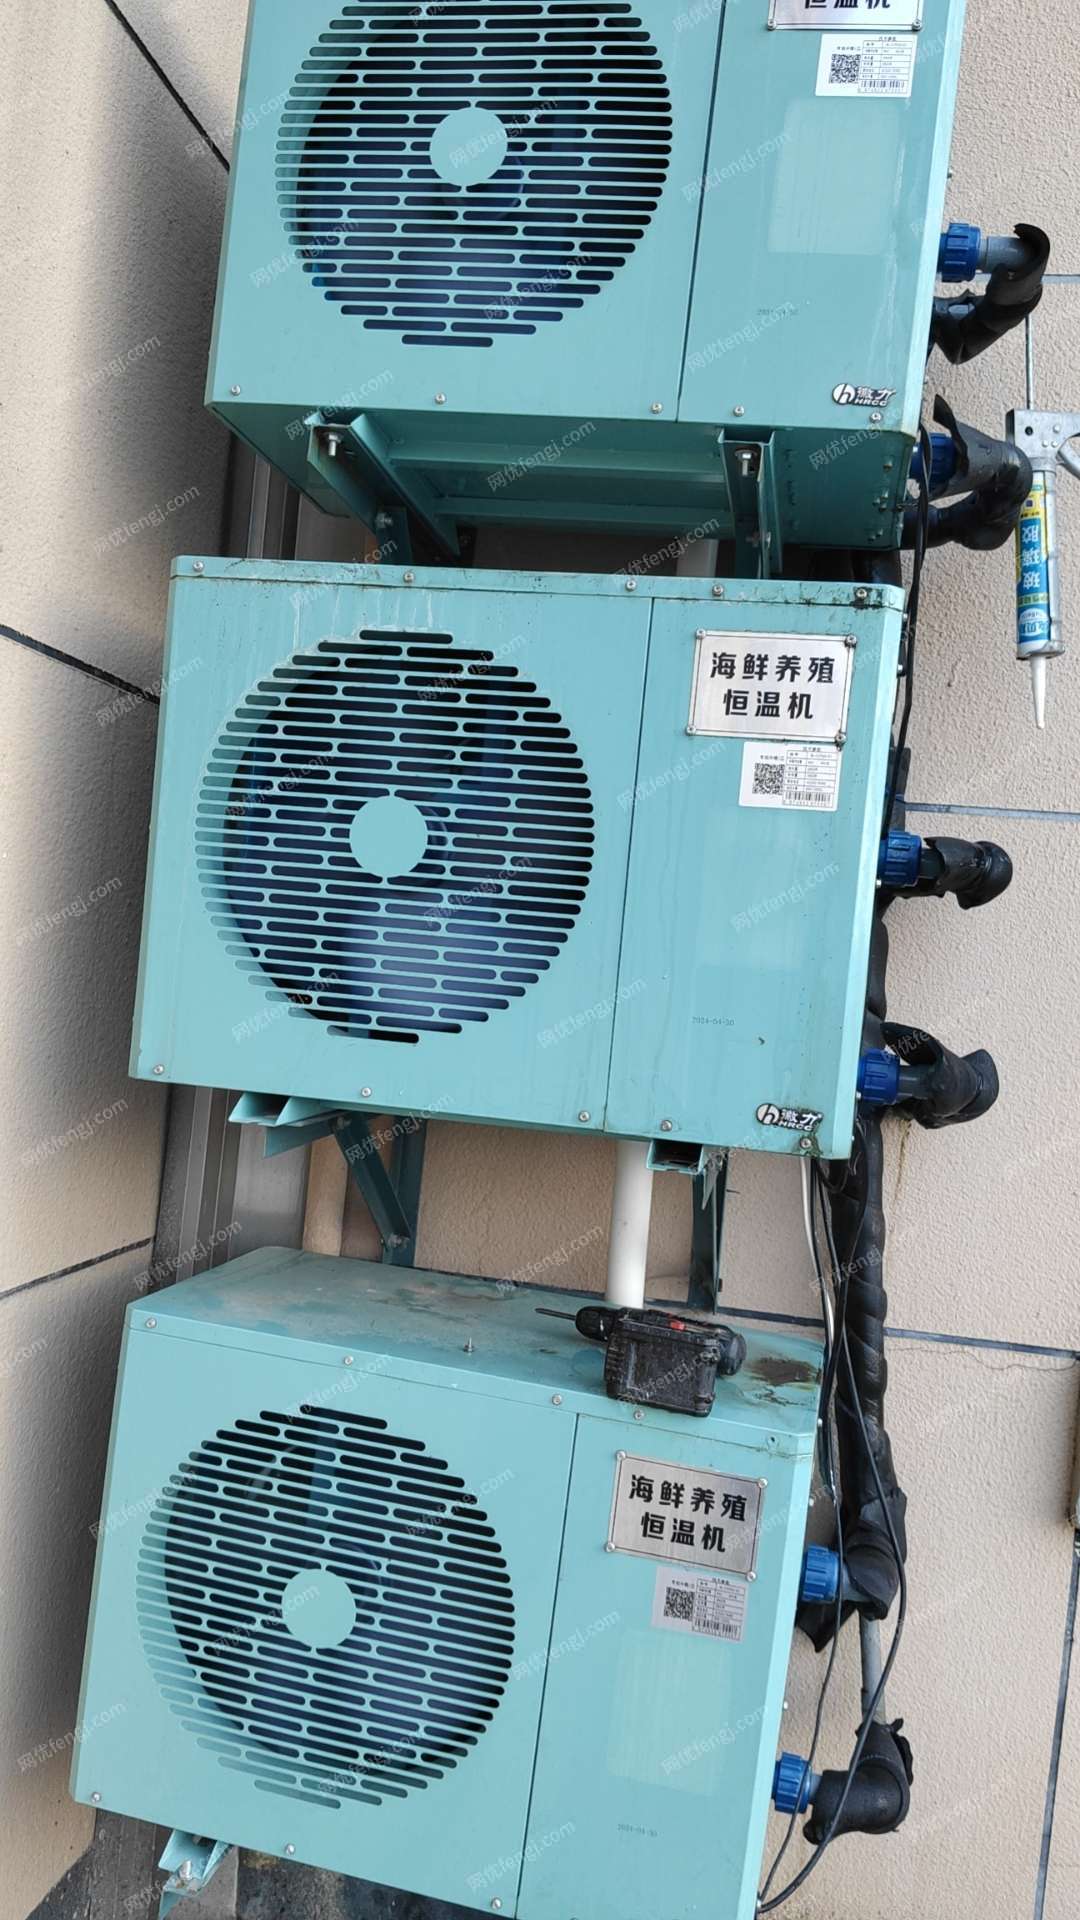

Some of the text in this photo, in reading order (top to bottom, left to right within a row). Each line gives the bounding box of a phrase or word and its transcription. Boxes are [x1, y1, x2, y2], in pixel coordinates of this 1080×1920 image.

[1021, 524, 1041, 590] 玻璃胶
[710, 652, 835, 684] 海鲜养殖
[723, 688, 813, 719] 恒温机
[629, 1474, 747, 1522] 海鲜养殖
[641, 1511, 726, 1553] 恒温机
